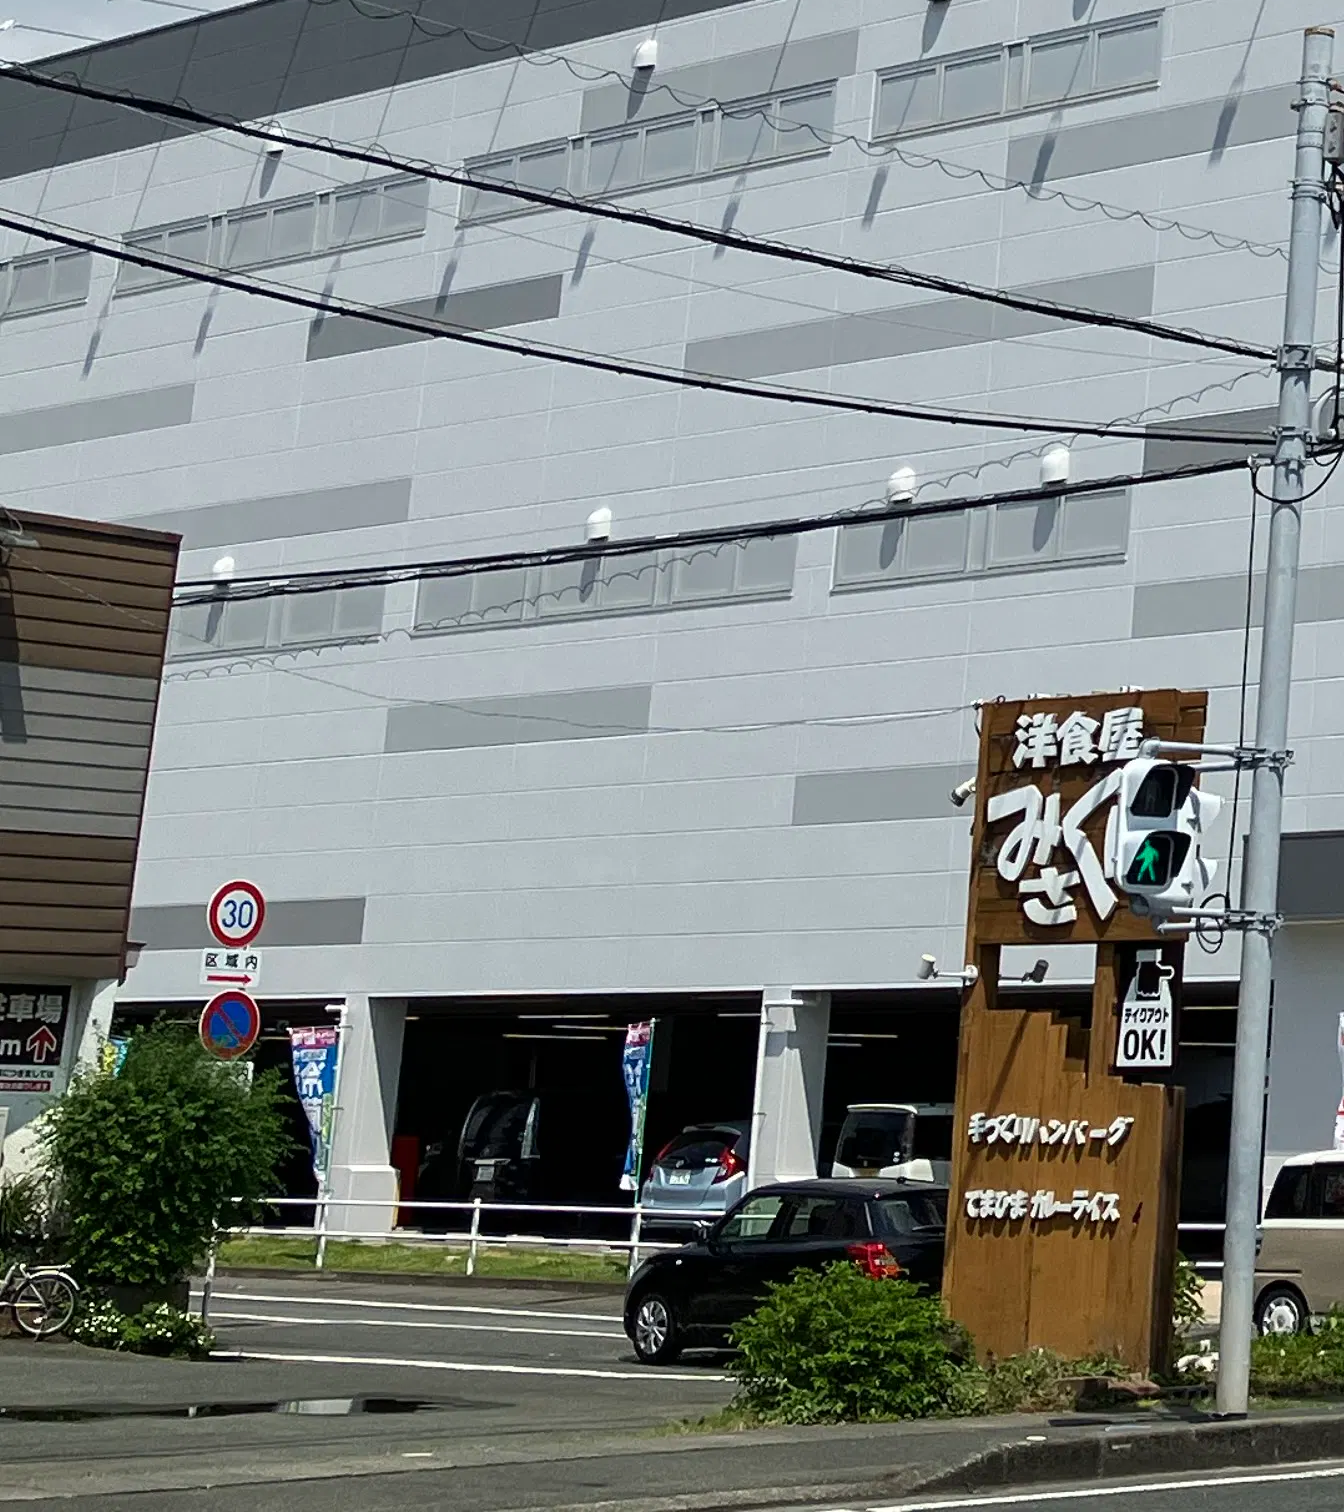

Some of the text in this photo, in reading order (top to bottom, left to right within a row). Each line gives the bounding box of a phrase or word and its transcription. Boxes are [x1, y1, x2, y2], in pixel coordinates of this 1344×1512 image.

[1012, 707, 1144, 769] 洋食屋
[222, 899, 254, 928] 30
[205, 952, 258, 970] 区域内
[1124, 1007, 1170, 1024] テイクアウト
[1123, 1029, 1166, 1061] OK!
[968, 1112, 1134, 1146] 手づくりハンバーグ
